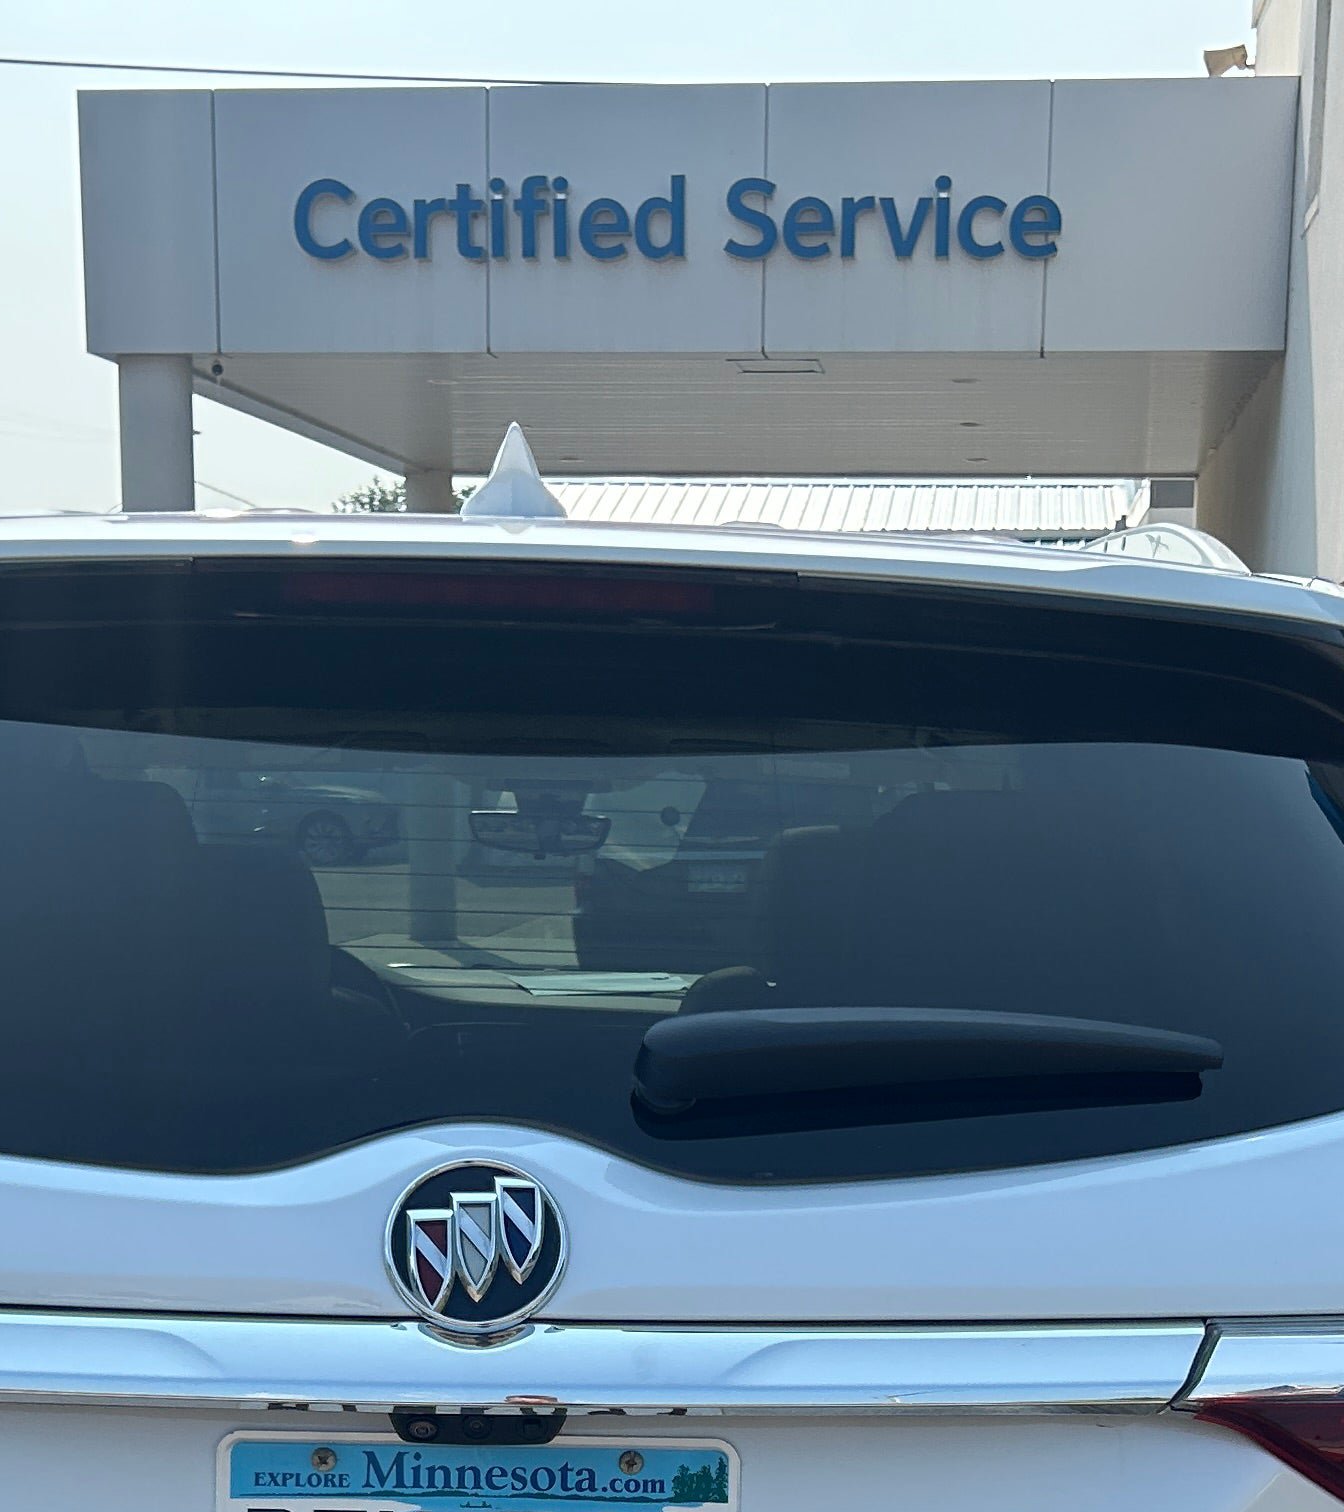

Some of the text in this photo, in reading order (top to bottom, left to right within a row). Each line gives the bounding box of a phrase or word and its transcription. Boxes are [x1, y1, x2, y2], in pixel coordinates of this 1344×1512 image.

[294, 174, 1063, 262] Certified Service
[254, 1450, 666, 1495] EXPLORE Minnesota.com
